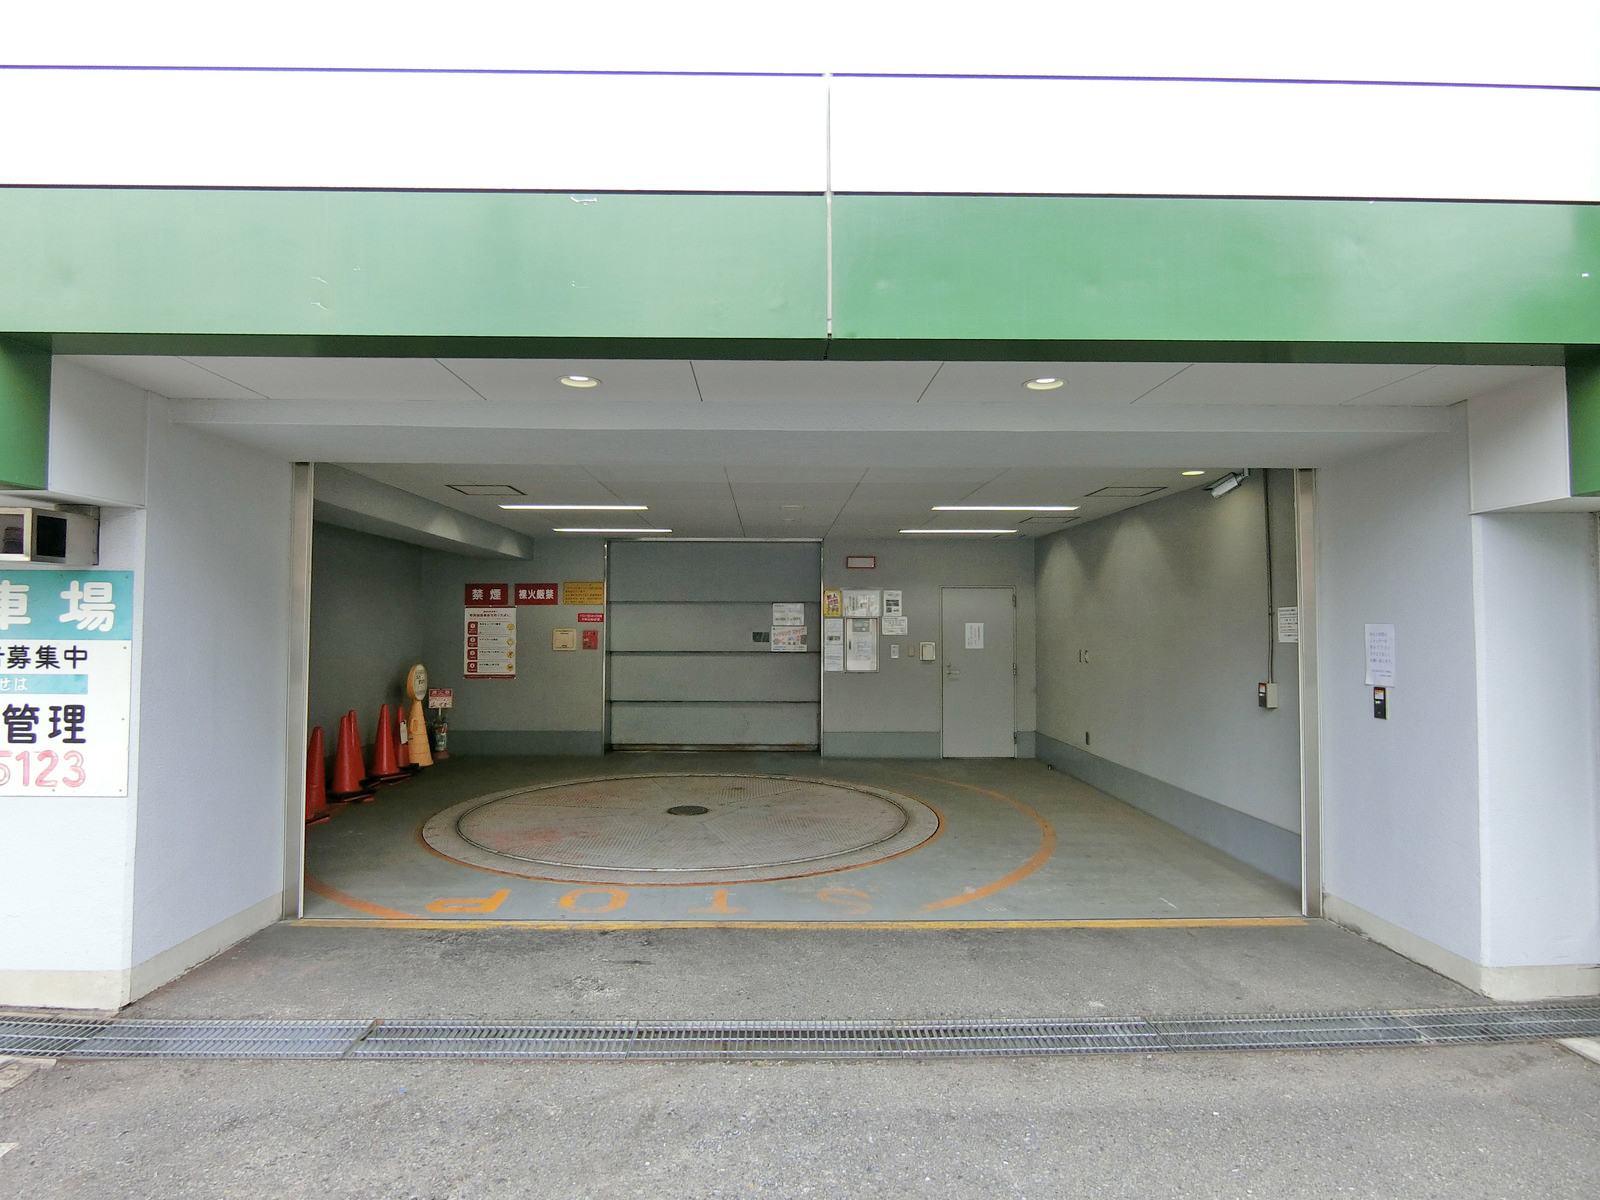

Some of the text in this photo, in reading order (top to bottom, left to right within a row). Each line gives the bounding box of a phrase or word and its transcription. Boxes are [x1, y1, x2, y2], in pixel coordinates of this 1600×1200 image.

[472, 588, 502, 601] 禁煙
[0, 645, 88, 669] 募集中
[2, 703, 86, 744] 管理
[426, 887, 874, 915] STOP
